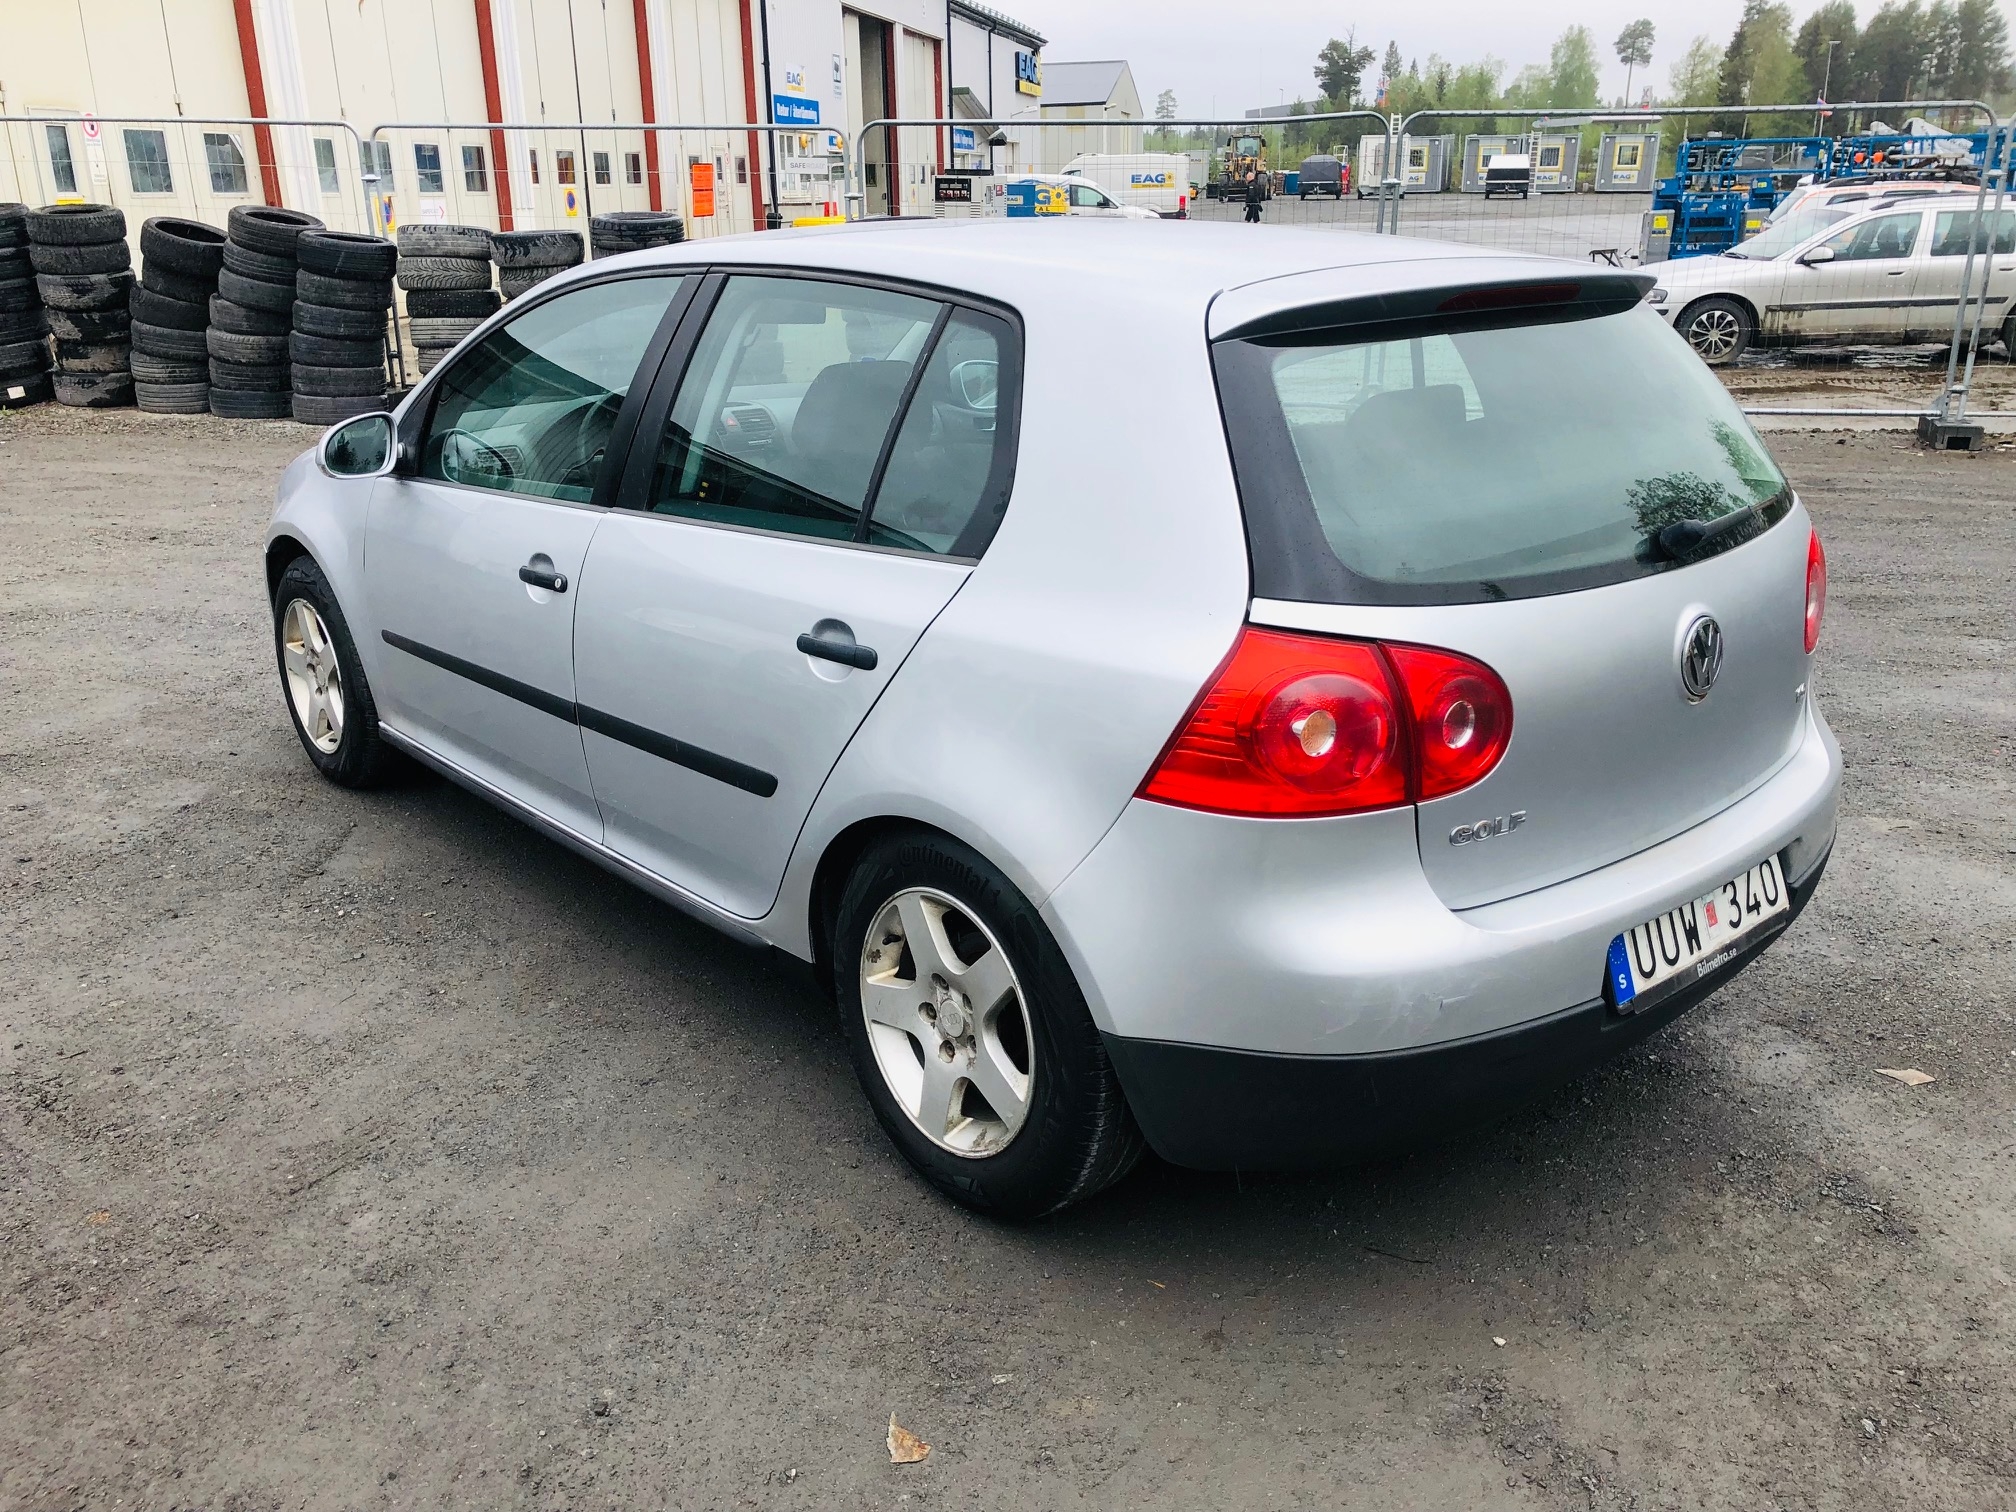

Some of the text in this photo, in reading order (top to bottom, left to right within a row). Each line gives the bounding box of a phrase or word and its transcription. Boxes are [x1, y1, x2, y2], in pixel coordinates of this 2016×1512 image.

[1131, 173, 1166, 183] EAG
[1449, 810, 1526, 847] GOLF
[1618, 973, 1627, 989] S
[1722, 859, 1779, 929] 340
[1696, 947, 1737, 978] Bilmetro.se
